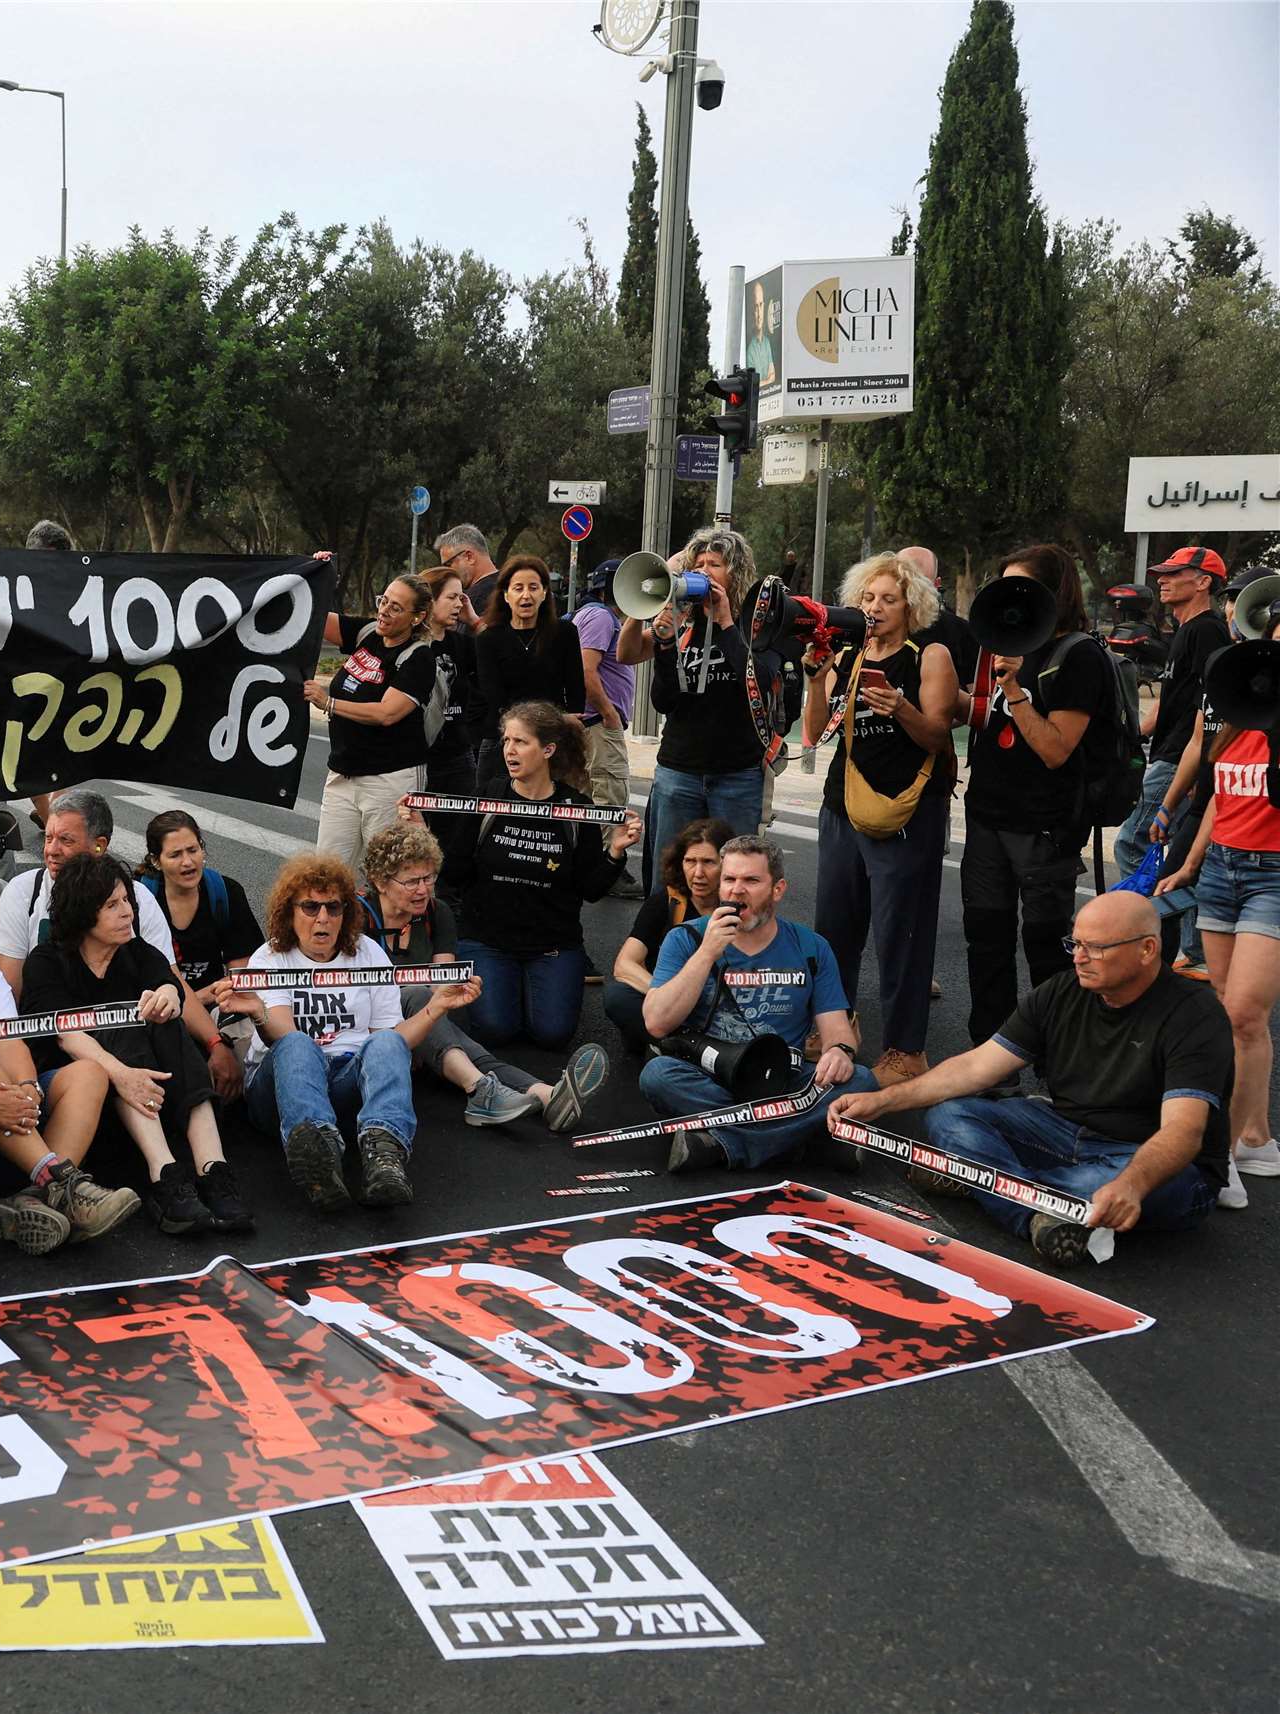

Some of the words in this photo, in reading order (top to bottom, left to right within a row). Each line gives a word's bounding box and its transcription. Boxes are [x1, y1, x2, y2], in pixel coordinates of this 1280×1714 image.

[816, 287, 899, 314] MICHA
[815, 314, 899, 342] LINETT
[791, 380, 820, 389] Rehavia
[821, 379, 858, 388] Jerusalem
[863, 378, 884, 386] Since
[1147, 480, 1248, 508] إسرائيل
[68, 573, 313, 665] 1000
[209, 664, 298, 767] של
[407, 794, 423, 807] 7.10
[422, 796, 436, 808] את
[437, 797, 463, 810] שכחנו
[463, 797, 476, 810] לא
[479, 800, 496, 812] 7.10
[496, 801, 510, 813] את
[511, 803, 537, 815] שכחנו
[537, 803, 551, 816] לא
[554, 806, 570, 818] 7.10
[570, 807, 584, 819] את
[585, 808, 613, 821] שכחנו
[613, 809, 626, 822] לא
[251, 974, 268, 987] את
[268, 973, 297, 986] שכחנו
[297, 971, 310, 985] לא
[315, 972, 333, 985] 7.10
[333, 971, 350, 985] את
[350, 971, 379, 984] שכחנו
[379, 969, 392, 983] לא
[395, 970, 414, 983] 7.10
[414, 969, 430, 982] את
[431, 968, 458, 981] שכחנו
[458, 967, 472, 981] לא
[724, 972, 744, 985] 7.10
[745, 972, 760, 985] את
[761, 972, 791, 985] שכחנו
[792, 971, 805, 985] לא
[232, 975, 250, 988] 7.10
[294, 990, 347, 1015] אתה
[39, 1016, 53, 1032] לא
[57, 1014, 78, 1029] 7.10
[78, 1012, 95, 1027] את
[95, 1010, 128, 1026] שכחנו
[7, 1018, 39, 1035] שכחנו
[754, 1102, 777, 1119] 7.10
[778, 1100, 795, 1115] את
[703, 1115, 736, 1129] שכחנו
[736, 1108, 752, 1122] לא
[834, 1121, 854, 1139] 7.10
[853, 1127, 867, 1144] את
[867, 1130, 897, 1153] שכחנו
[896, 1139, 910, 1158] לא
[912, 1147, 932, 1167] 7.10
[932, 1155, 948, 1173] את
[947, 1159, 979, 1183] שכחנו
[978, 1169, 994, 1188] לא
[997, 1176, 1018, 1196] 7.10
[1018, 1184, 1036, 1203] את
[1035, 1190, 1070, 1214] שכחנו
[1069, 1201, 1086, 1223] לא
[430, 1503, 639, 1544] ועדת
[403, 1545, 683, 1594] חקירה
[0, 1567, 282, 1609] במחדל
[449, 1601, 726, 1644] ממלכתית
